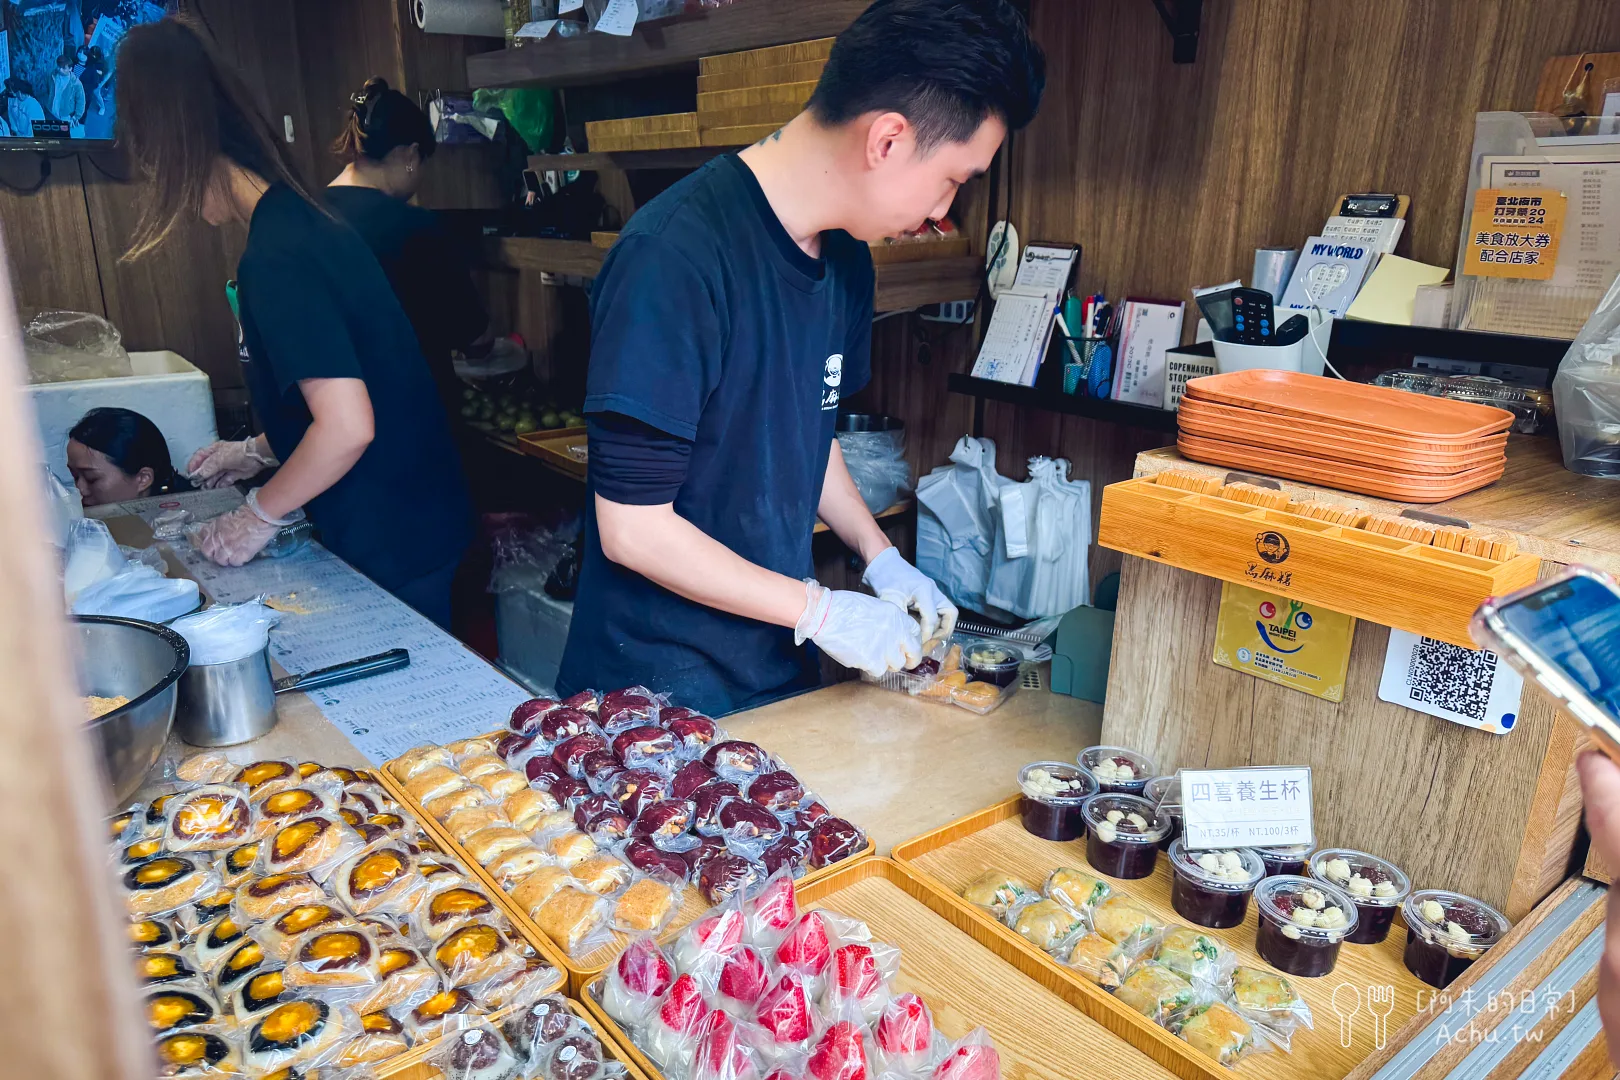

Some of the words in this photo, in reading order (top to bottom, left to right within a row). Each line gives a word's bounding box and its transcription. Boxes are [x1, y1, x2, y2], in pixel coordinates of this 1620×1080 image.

[1495, 196, 1543, 206] 臺北夜市
[1529, 208, 1547, 216] 20
[1527, 216, 1545, 224] 24
[1475, 231, 1551, 248] 美食放大券
[1328, 245, 1364, 260] WORLD
[1480, 249, 1540, 265] 配合店家
[1269, 623, 1297, 638] TAIPEI
[1191, 779, 1301, 802] 四喜養生杯
[1248, 825, 1299, 837] NT.100/3杯
